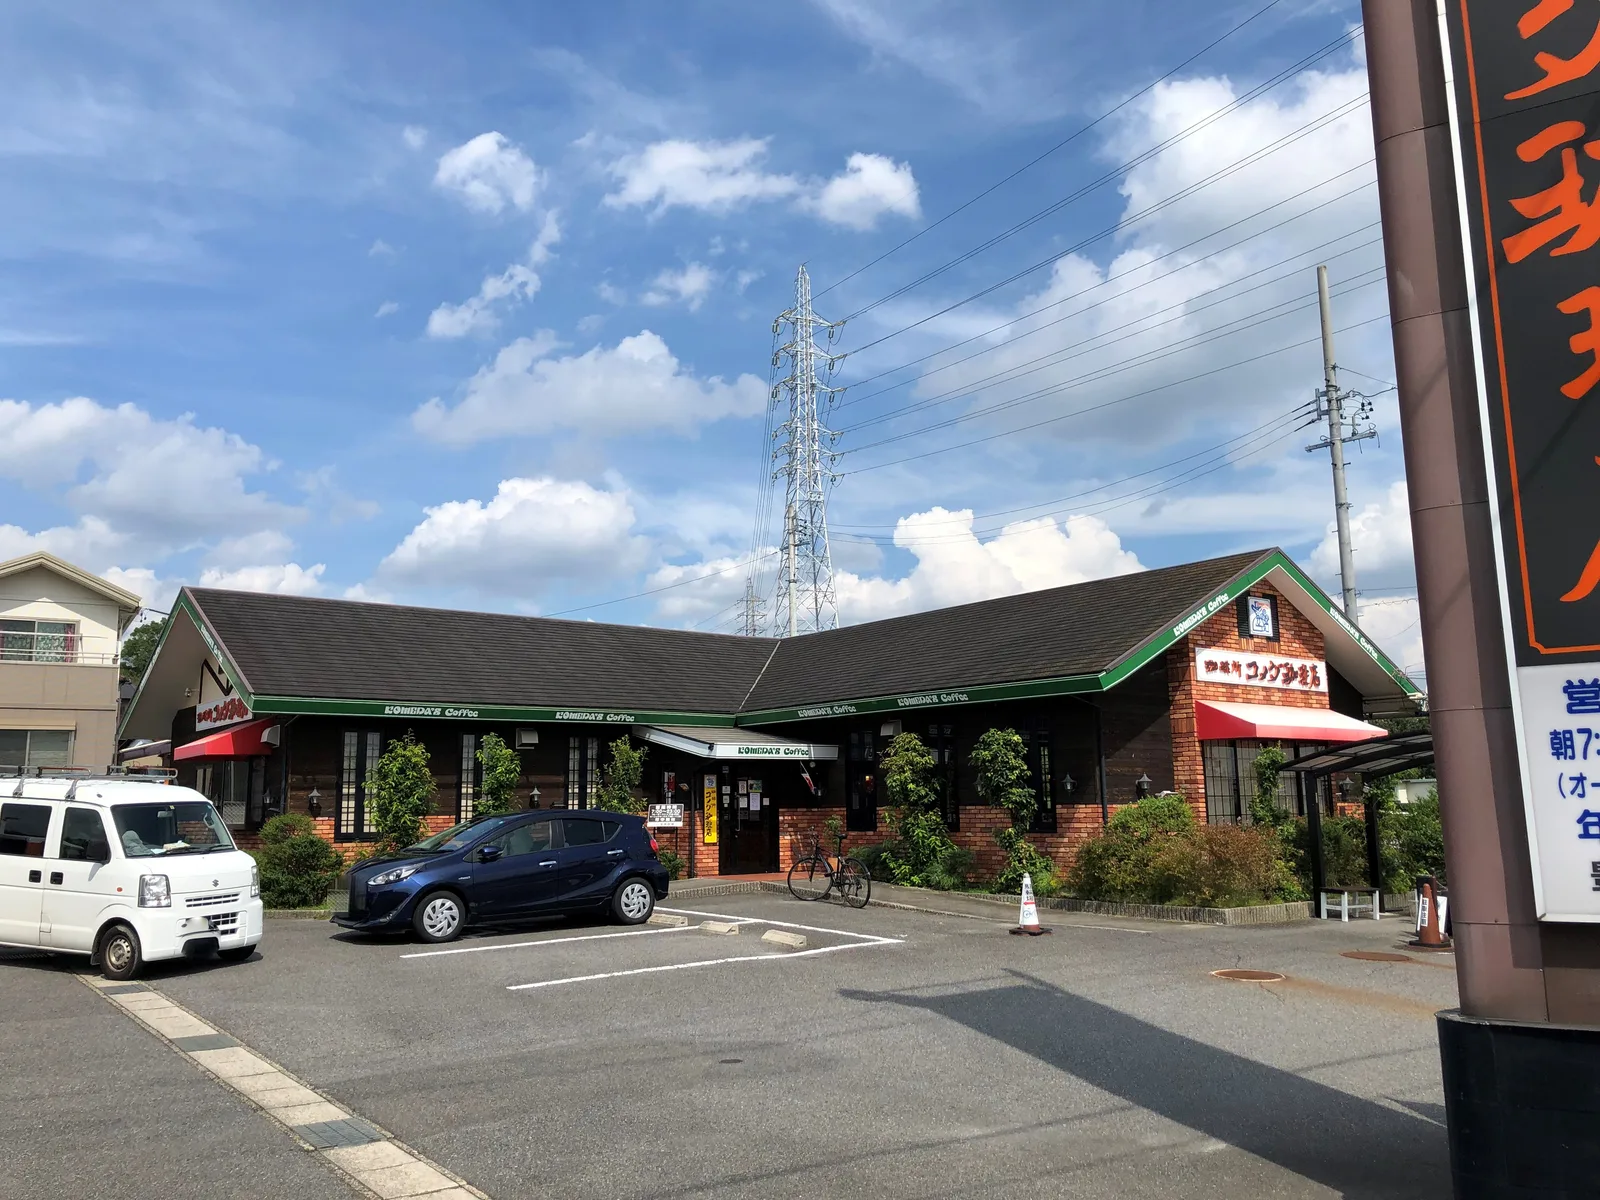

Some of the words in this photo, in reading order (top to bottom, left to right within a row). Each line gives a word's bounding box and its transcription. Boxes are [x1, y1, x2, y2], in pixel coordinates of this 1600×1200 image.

[1207, 593, 1229, 611] Coffee
[897, 695, 939, 706] KOMEDA'S
[941, 692, 969, 702] Coffee
[384, 705, 441, 716] KOMEDA'S
[444, 708, 479, 718] Coffee
[555, 711, 603, 721] KOMEDA'S
[606, 713, 635, 722] Coffee
[797, 707, 832, 718] KOMEDA'S
[833, 705, 857, 715] Coffee
[738, 746, 781, 756] KOMEDA'S
[783, 747, 809, 756] Coffee
